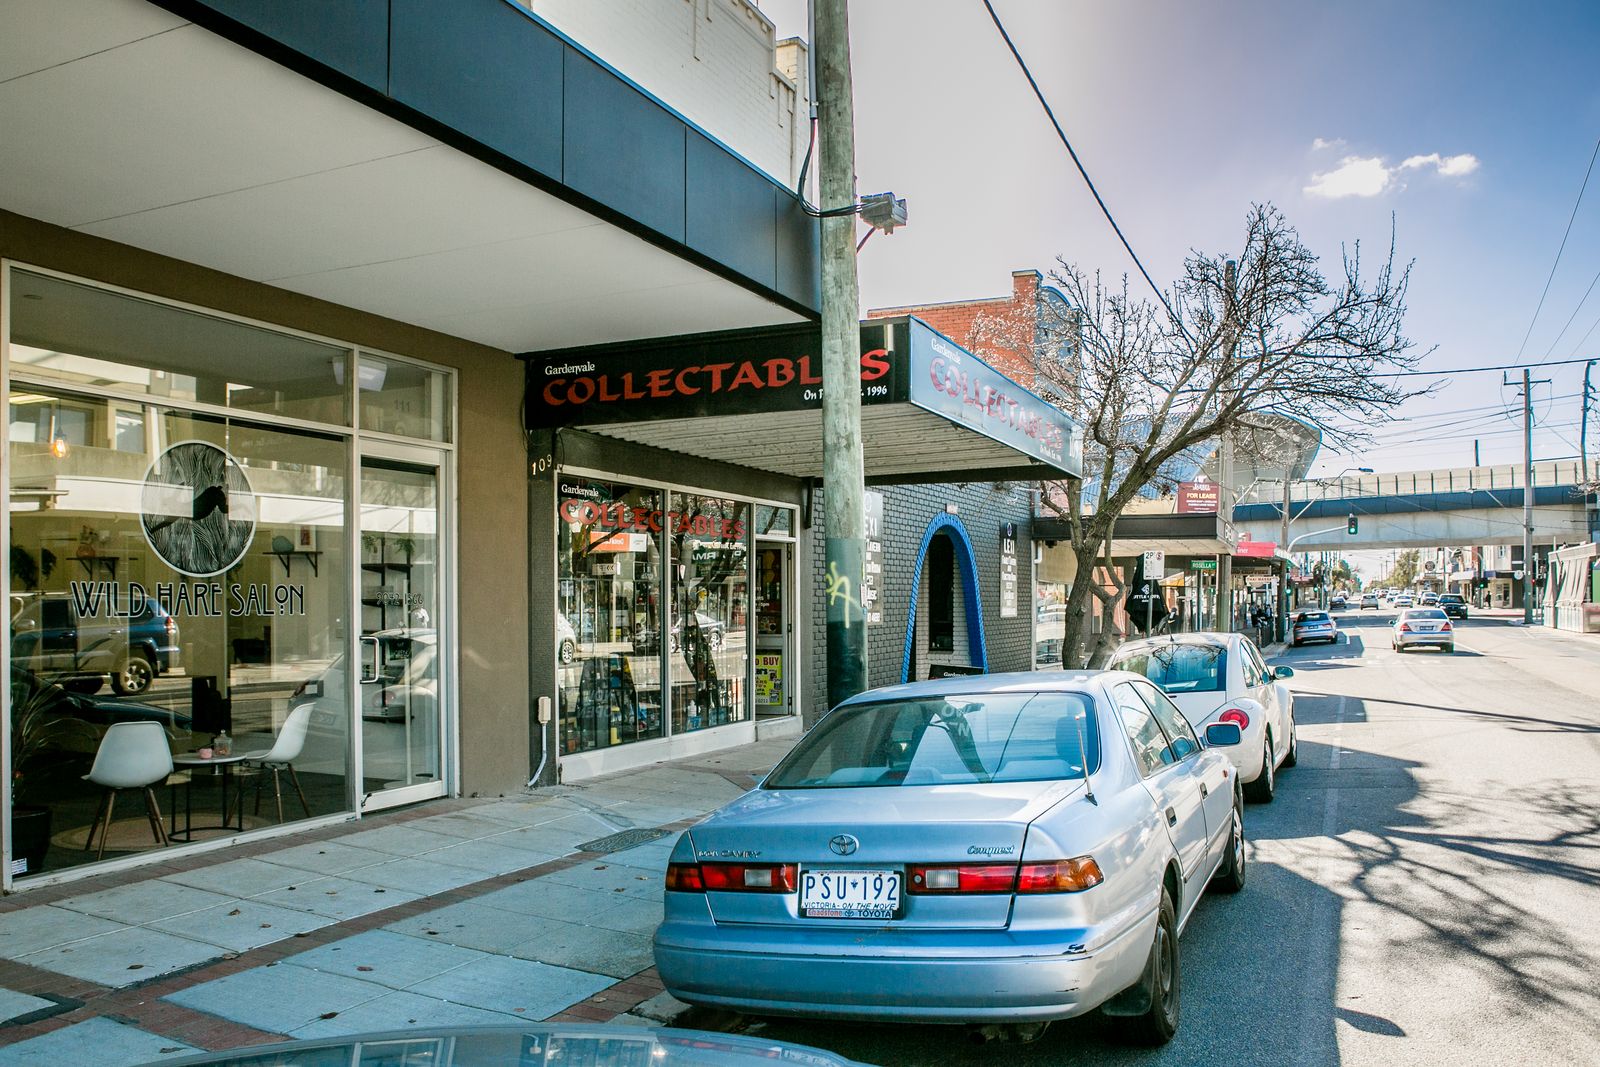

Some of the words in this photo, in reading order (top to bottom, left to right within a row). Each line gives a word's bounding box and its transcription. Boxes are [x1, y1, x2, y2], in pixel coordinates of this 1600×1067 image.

[545, 361, 596, 377] Gardenvale
[543, 349, 891, 406] COLLECTABLS
[804, 389, 817, 400] On
[867, 385, 888, 396] 1996
[930, 356, 1064, 451] COLLECTABLES
[532, 454, 552, 475] 109
[561, 484, 599, 500] Gardenvale
[560, 498, 747, 541] COLLECTABLES
[865, 516, 877, 537] EXI
[71, 581, 147, 618] WILD
[156, 581, 222, 617] HARE
[230, 583, 305, 617] SALON
[763, 656, 779, 666] BUY
[967, 845, 1015, 858] Conquest
[858, 909, 892, 918] TOYOTA
[872, 903, 896, 911] MOVE
